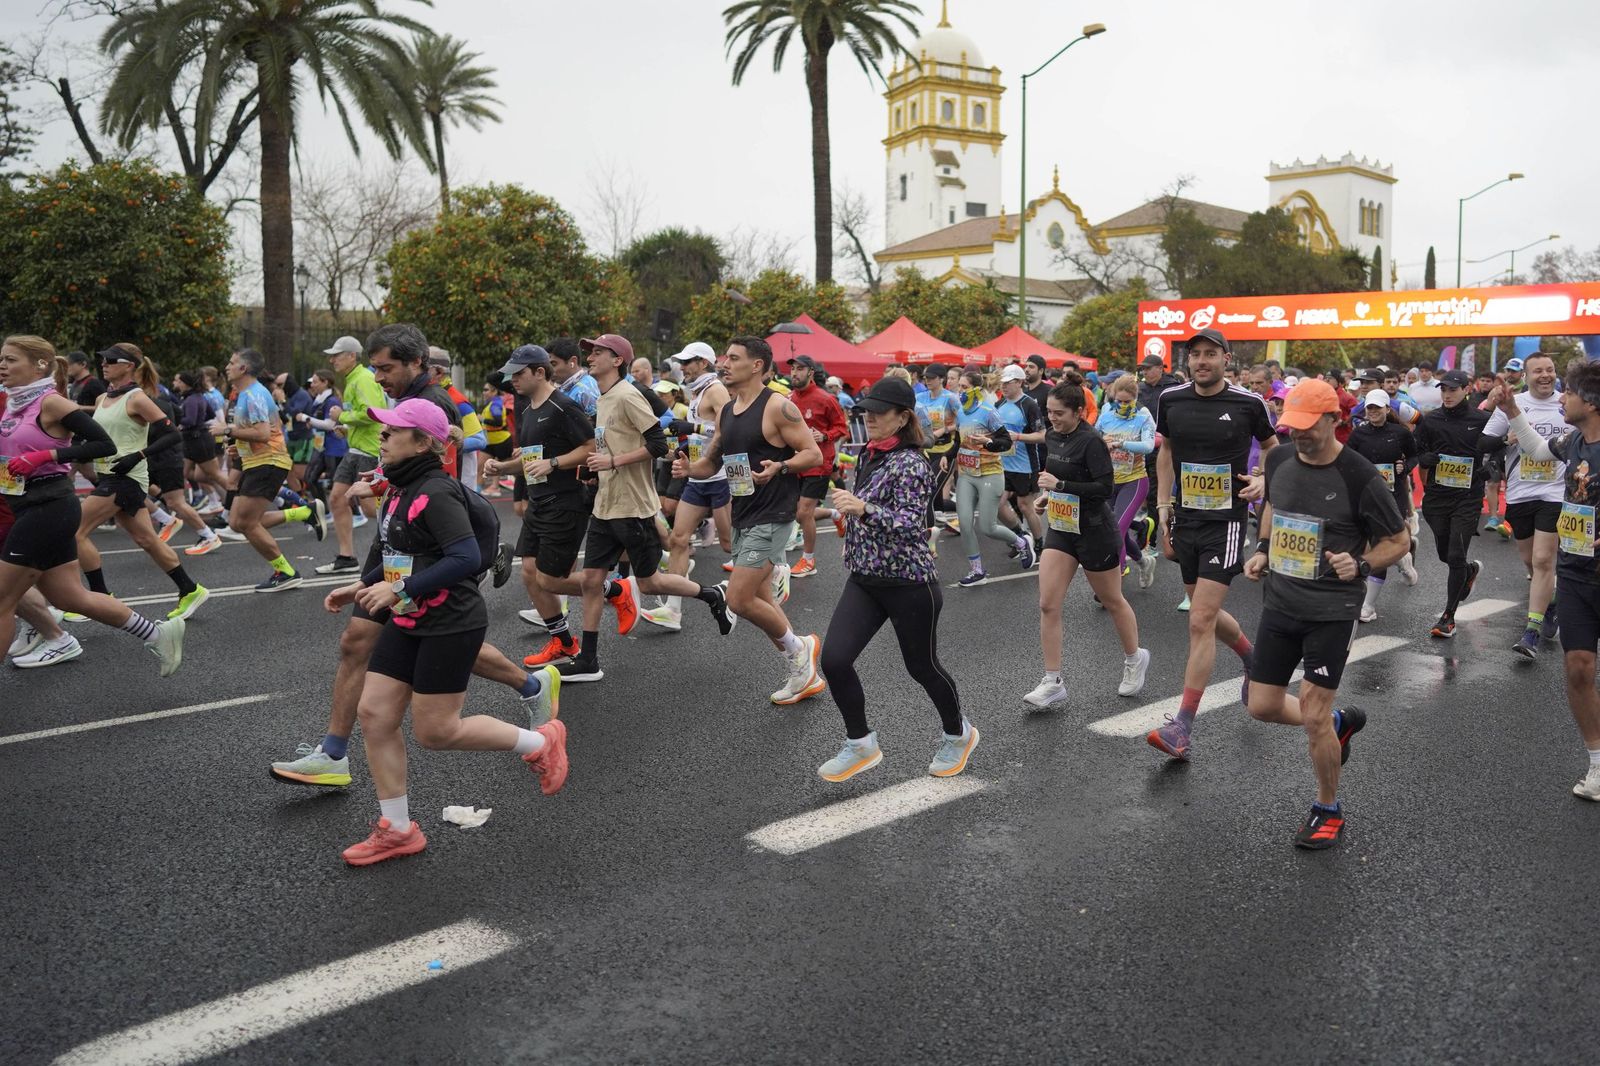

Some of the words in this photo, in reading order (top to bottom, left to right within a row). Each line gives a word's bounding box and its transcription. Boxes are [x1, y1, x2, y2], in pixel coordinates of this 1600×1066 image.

[1439, 462, 1468, 475] 17242
[1185, 474, 1222, 490] 17021
[1048, 501, 1073, 517] 17020
[1275, 530, 1317, 554] 13886
